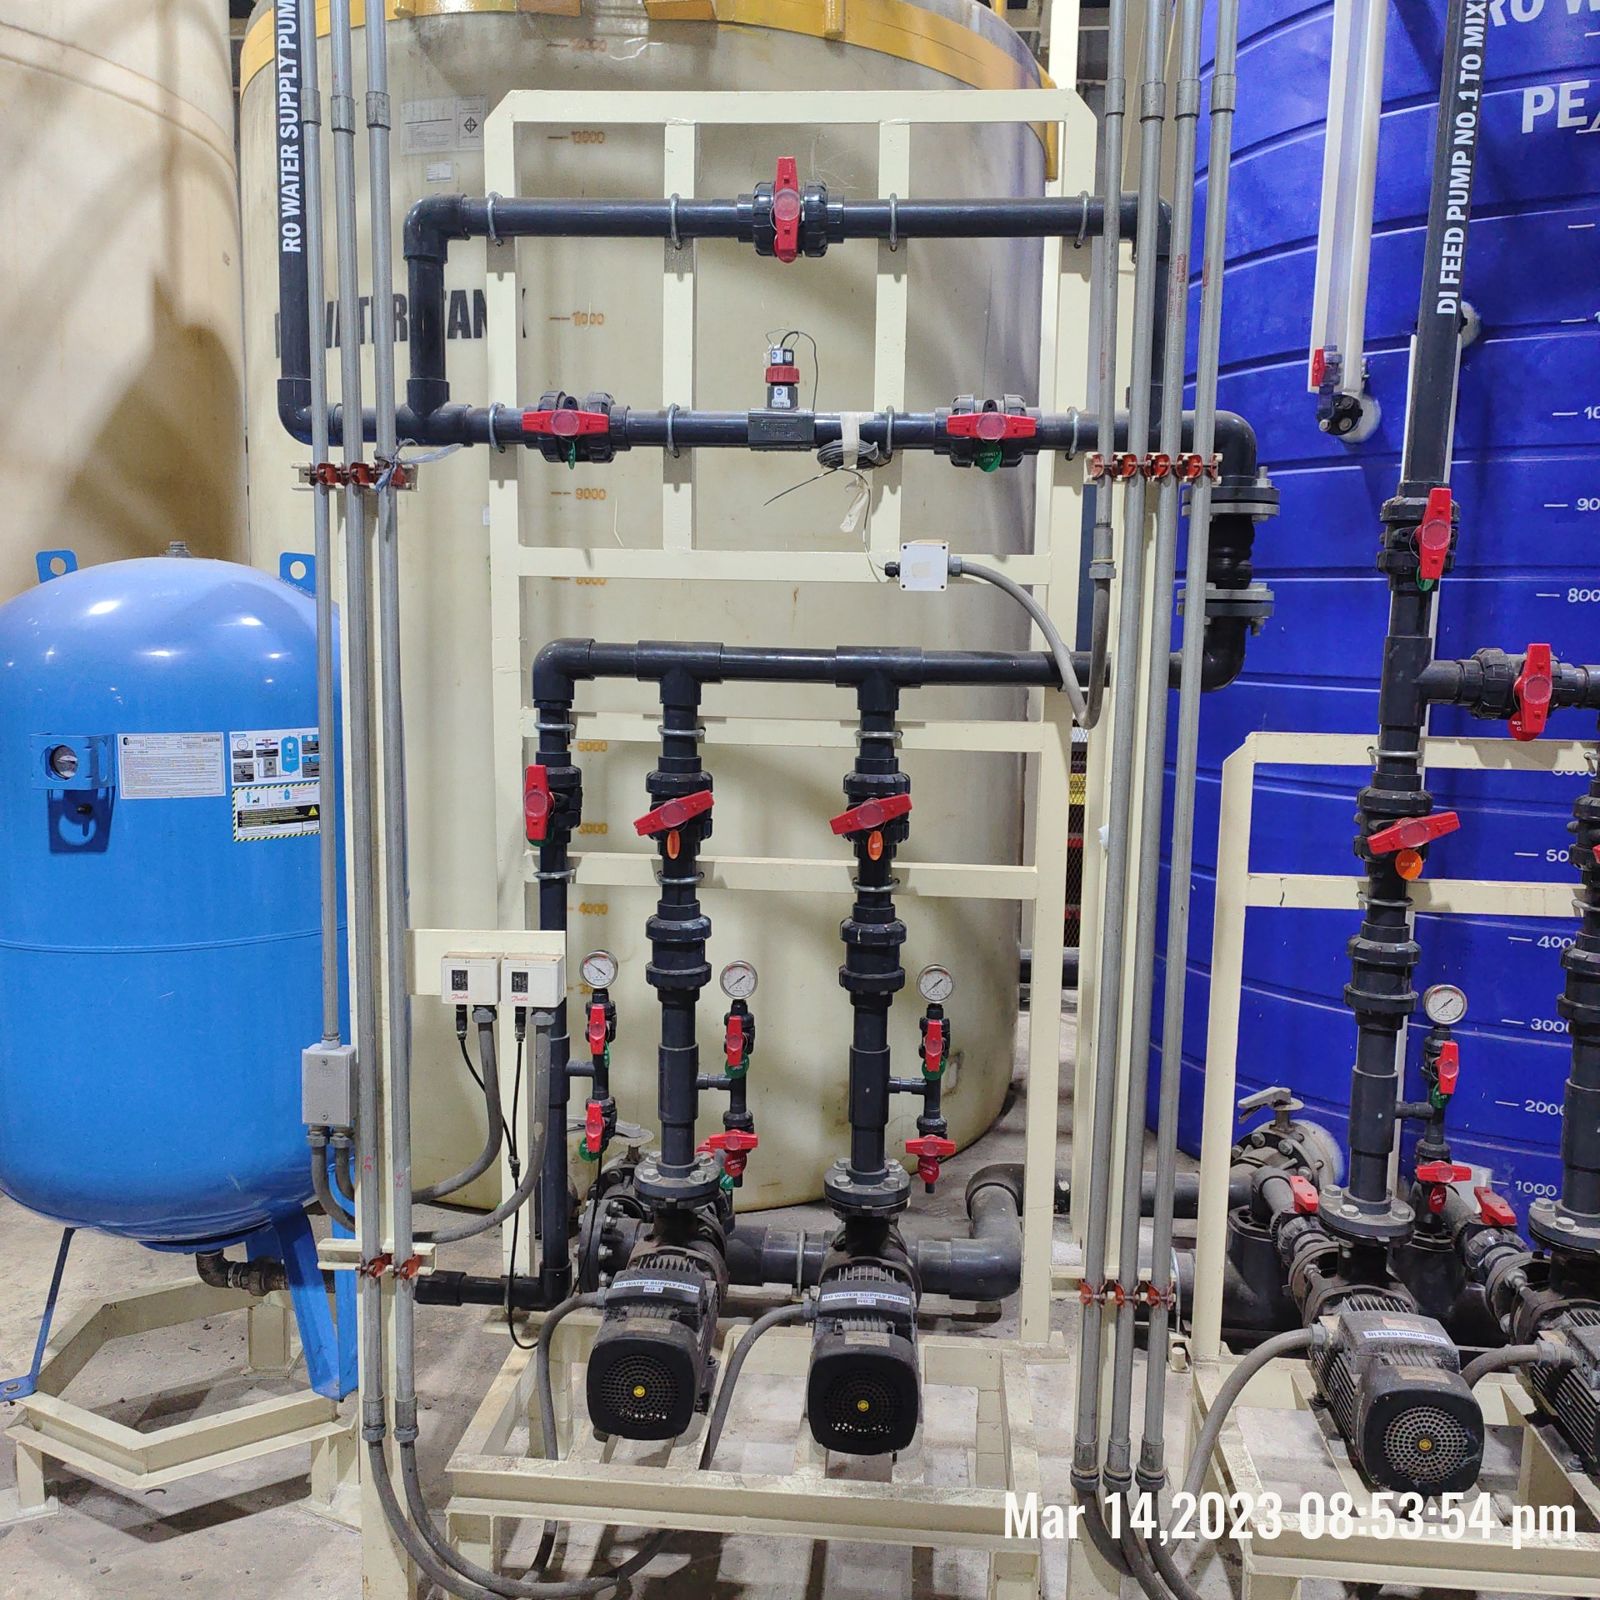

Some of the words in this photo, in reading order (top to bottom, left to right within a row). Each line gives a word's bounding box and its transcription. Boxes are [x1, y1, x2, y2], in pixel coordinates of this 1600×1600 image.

[1463, 0, 1487, 48] MIX
[1460, 53, 1482, 84] TO
[279, 53, 300, 139] SUPPLY
[280, 144, 300, 218] WATER
[1446, 150, 1472, 221] PUMP
[282, 222, 301, 253] RO
[1440, 227, 1464, 284] FEED
[1436, 291, 1459, 314] DI
[575, 487, 608, 501] 9000
[1515, 1180, 1557, 1197] 1000
